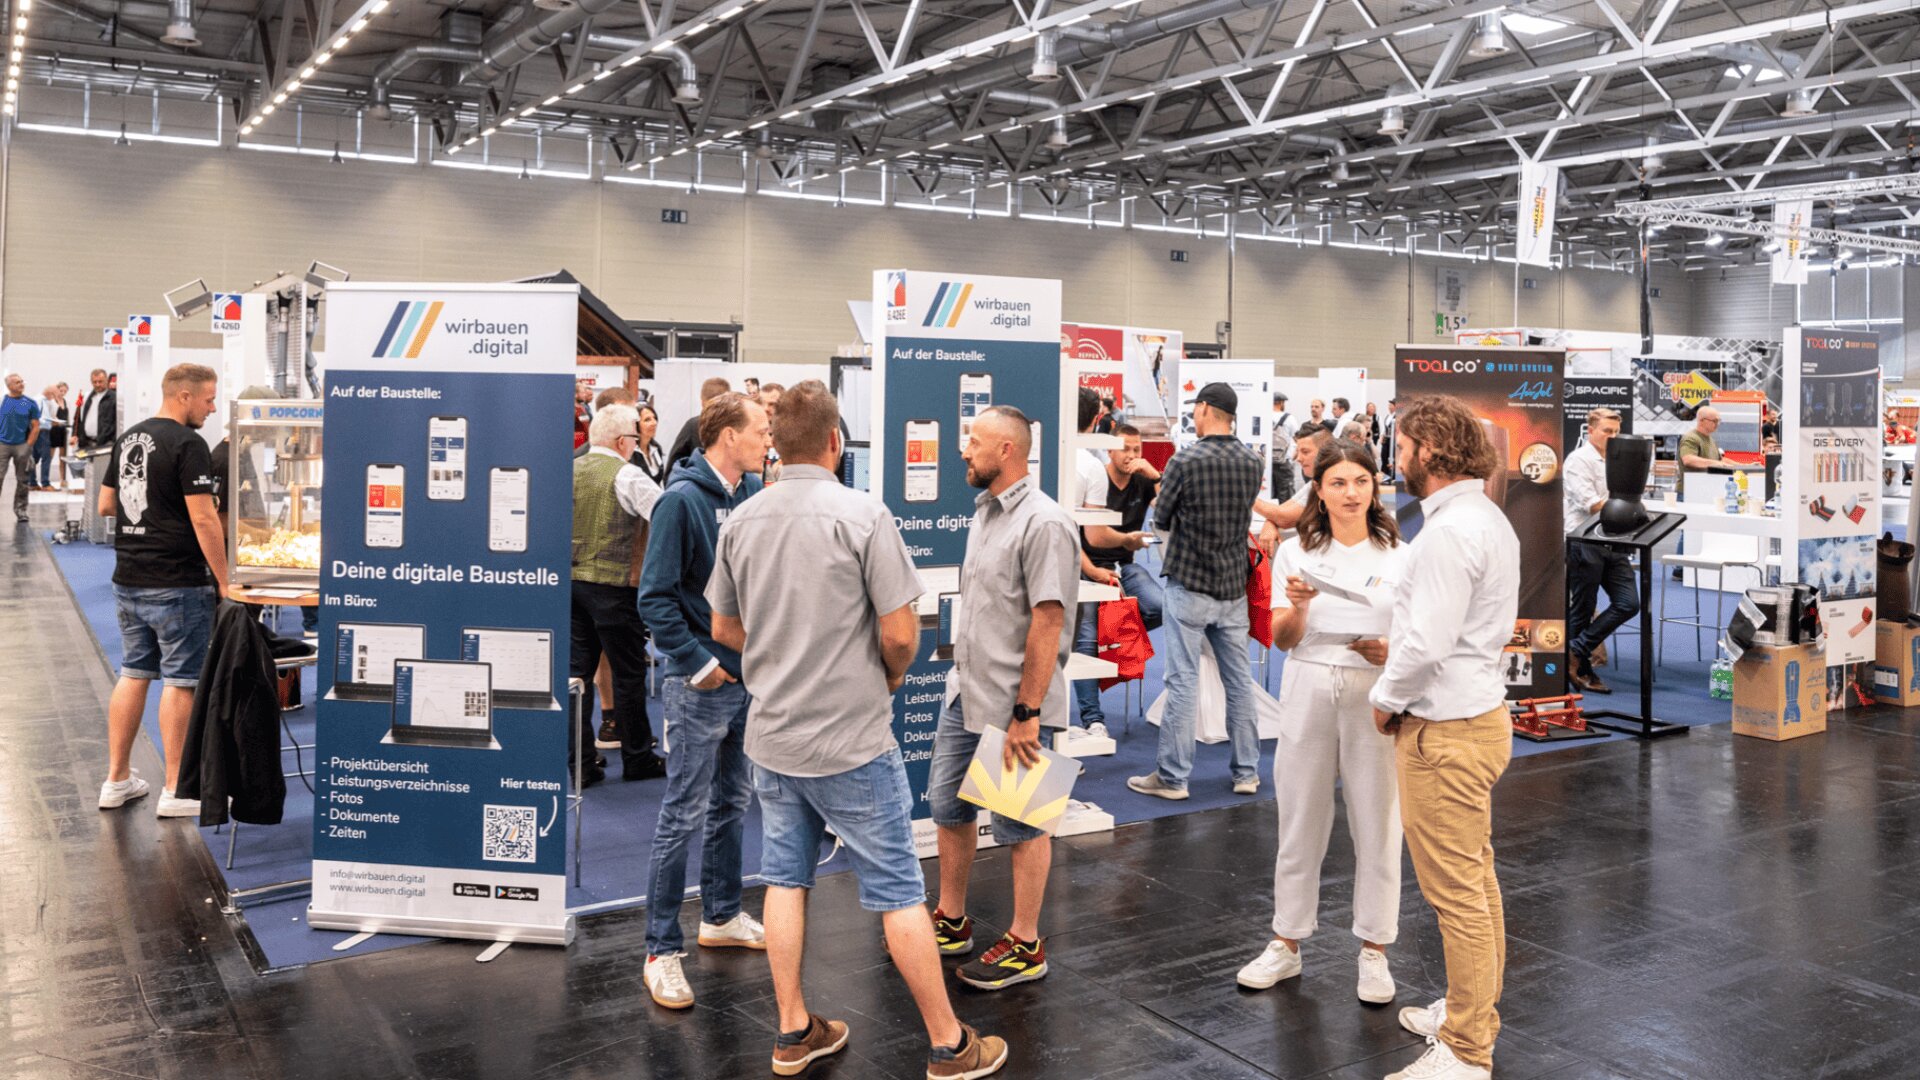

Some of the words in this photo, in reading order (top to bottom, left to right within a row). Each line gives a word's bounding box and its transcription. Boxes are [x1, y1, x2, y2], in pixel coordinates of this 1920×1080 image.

[974, 298, 1031, 312] wirbauen
[445, 318, 529, 335] wirbauen
[990, 314, 1031, 329] .digital
[468, 339, 529, 358] .digital
[892, 348, 912, 360] Auf
[915, 349, 932, 360] der
[936, 350, 986, 361] Baustelle:
[1663, 372, 1694, 384] GRUPA
[330, 385, 355, 398] Auf
[357, 385, 378, 398] der
[380, 386, 442, 400] Baustelle:
[1575, 385, 1629, 396] SPACIFIC
[269, 407, 324, 418] POPCORN
[893, 515, 933, 530] Deine
[332, 560, 387, 580] Deine
[392, 562, 464, 585] digitale
[470, 565, 559, 586] Baustelle
[324, 593, 341, 606] Im
[344, 594, 377, 608] Büro:
[905, 671, 947, 687] Projektü
[904, 712, 934, 724] Fotos
[330, 757, 430, 774] Projektübersicht
[330, 775, 471, 794] Leistungsverzeichnisse
[500, 778, 523, 790] Hier
[526, 778, 561, 792] testen
[329, 791, 363, 805] Fotos
[329, 809, 400, 824] Dokumente
[328, 825, 367, 840] Zeiten
[329, 868, 426, 885] info@wirbauen.digital
[329, 884, 426, 899] www.wirbauen.digital
